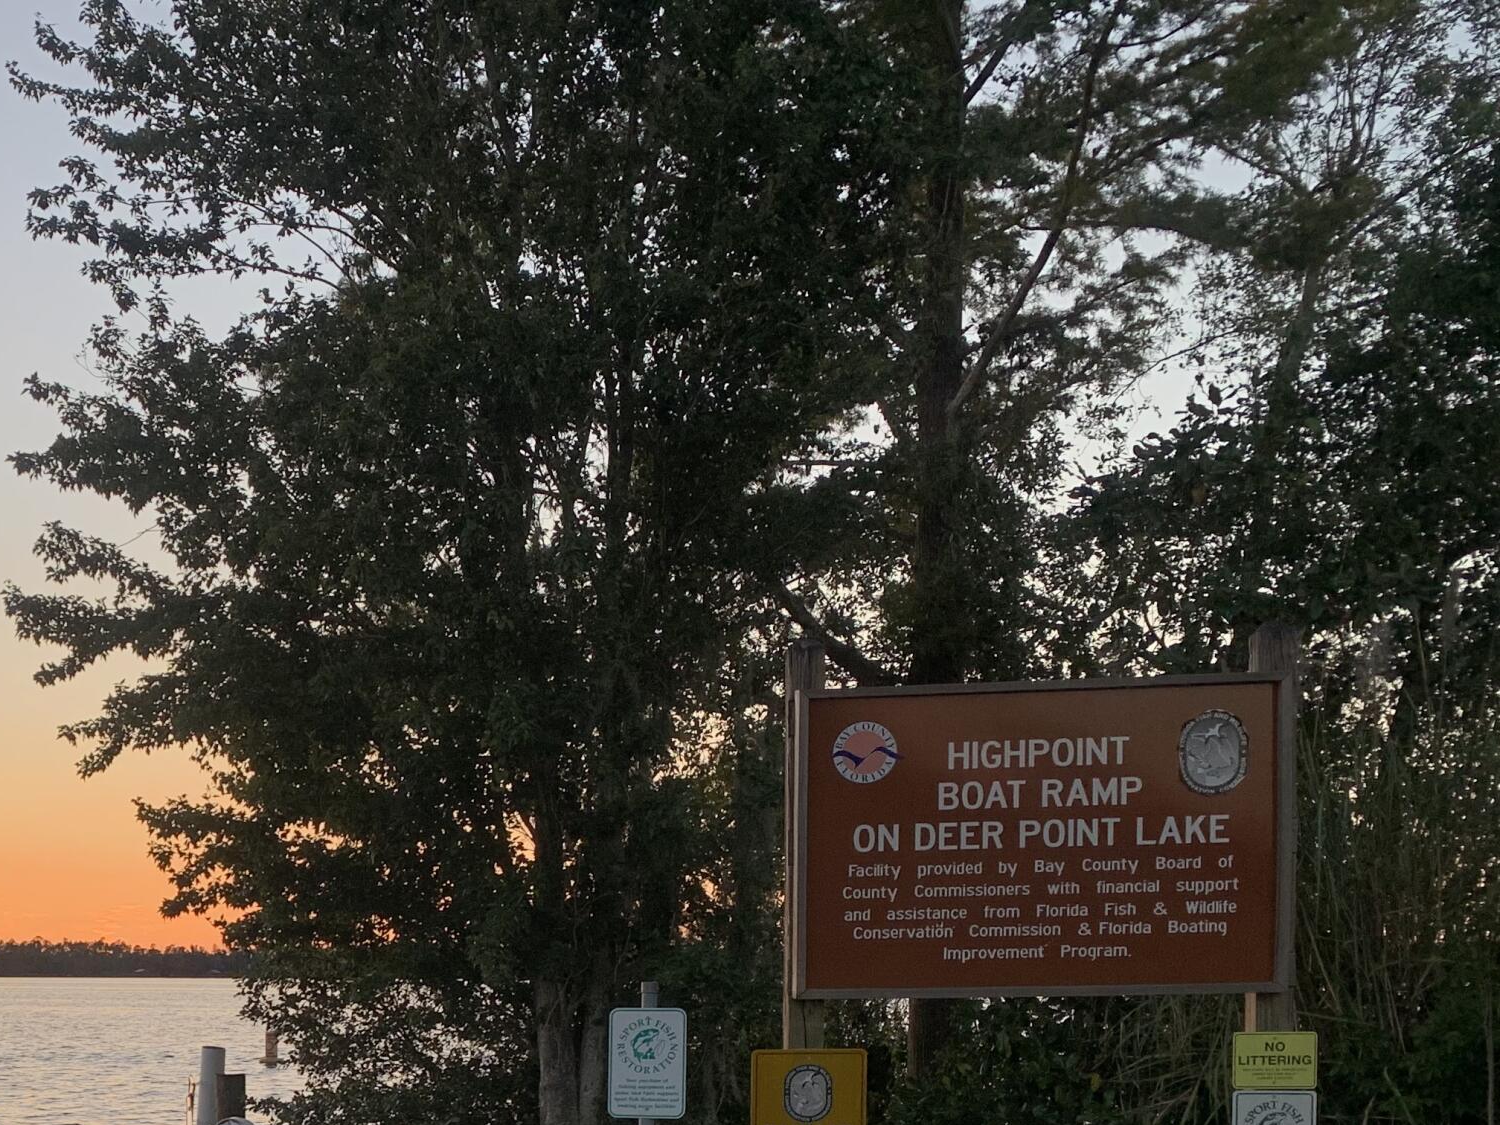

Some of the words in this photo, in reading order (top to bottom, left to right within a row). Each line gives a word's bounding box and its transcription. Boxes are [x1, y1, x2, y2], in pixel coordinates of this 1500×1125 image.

[836, 731, 851, 749] BAY
[853, 723, 895, 748] COUNTY
[947, 736, 1130, 770] HIGHPOINT
[836, 760, 893, 782] FLORIDA
[938, 780, 1026, 811] BOAT
[1041, 776, 1143, 808] RAMP
[853, 823, 900, 853] ON
[914, 820, 1004, 851] DEER
[1019, 817, 1121, 848] POINT
[1136, 814, 1230, 846] LAKE
[848, 864, 901, 880] Facility
[917, 861, 983, 879] provided
[998, 861, 1018, 878] by
[1034, 860, 1065, 876] Bay
[1082, 858, 1139, 875] County
[1156, 856, 1202, 870] Board
[1218, 854, 1234, 868] of
[842, 886, 898, 902] County
[914, 883, 1030, 898] Commissioners
[1047, 881, 1080, 895] with
[1096, 879, 1160, 894] financial
[1176, 877, 1239, 895] support
[844, 908, 871, 921] and
[886, 906, 968, 920] assistance
[983, 905, 1020, 919] from
[1036, 904, 1089, 917] Florida
[1104, 902, 1136, 916] Fish
[1153, 902, 1168, 916] &
[1185, 900, 1237, 915] Wildlife
[853, 925, 954, 940] Conservation
[969, 923, 1061, 938] Commission
[1077, 922, 1092, 936] &
[1099, 920, 1152, 935] Florida
[1167, 919, 1228, 936] Boating
[943, 945, 1045, 963] Improvement
[1060, 944, 1132, 961] Program.
[619, 1016, 653, 1042] SPORT
[655, 1019, 677, 1041] FISH
[617, 1043, 679, 1074] RESTORATION
[1264, 1041, 1286, 1052] NO
[1238, 1055, 1312, 1066] LITTERING
[1244, 1100, 1277, 1124] SPORT
[1281, 1102, 1304, 1124] FISH
